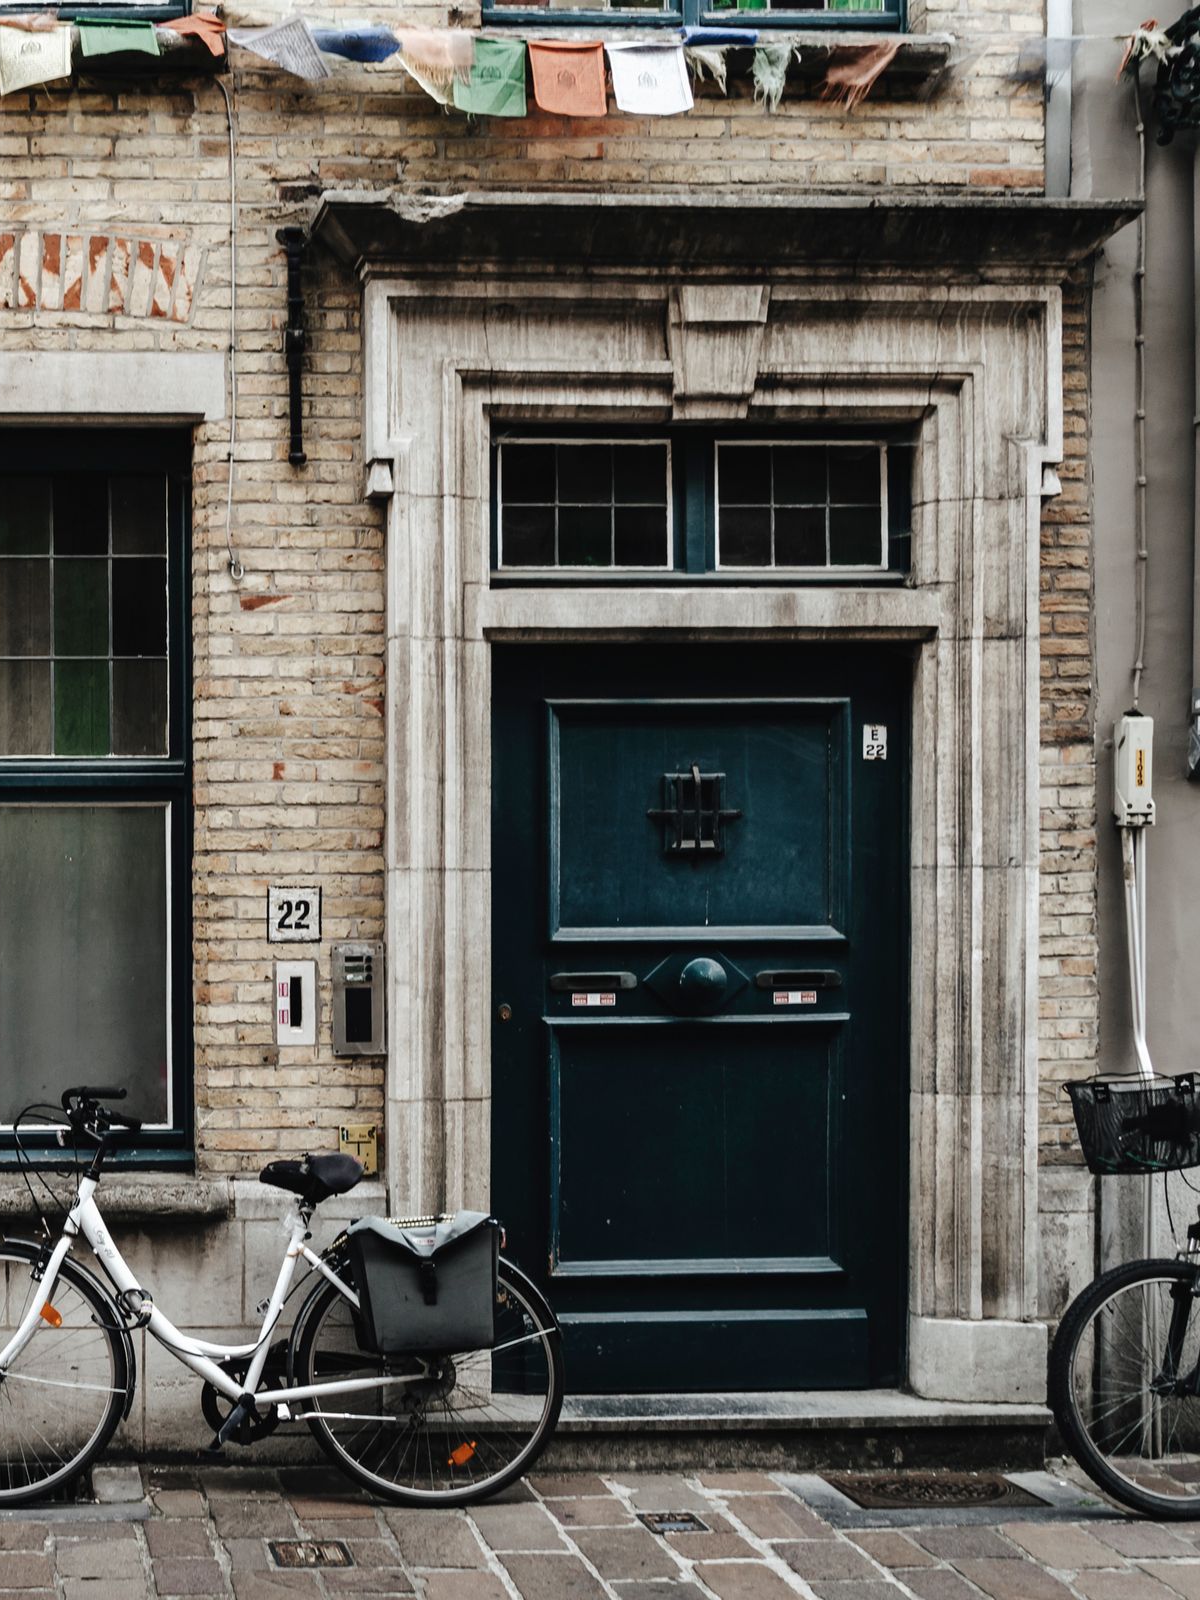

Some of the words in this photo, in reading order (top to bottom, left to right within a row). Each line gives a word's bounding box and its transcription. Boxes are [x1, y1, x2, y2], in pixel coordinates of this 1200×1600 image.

[871, 729, 879, 741] E
[866, 744, 885, 756] 22
[277, 900, 310, 930] 22
